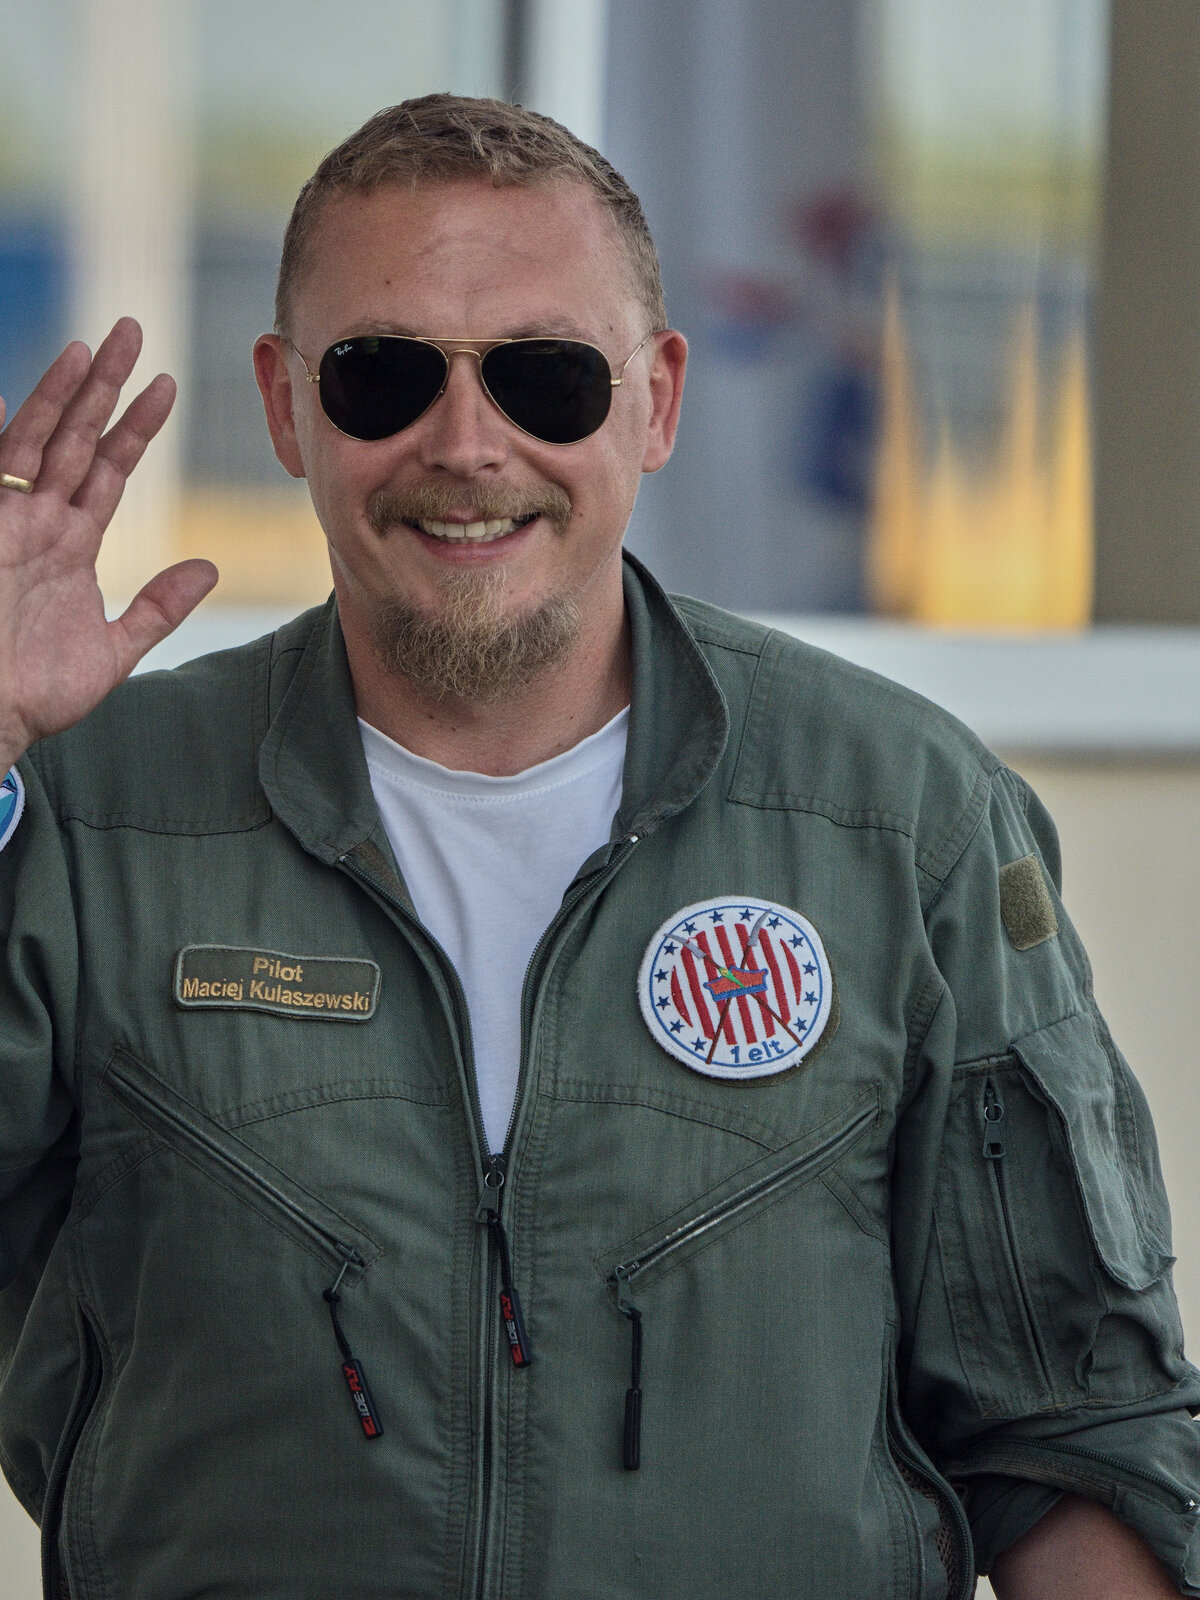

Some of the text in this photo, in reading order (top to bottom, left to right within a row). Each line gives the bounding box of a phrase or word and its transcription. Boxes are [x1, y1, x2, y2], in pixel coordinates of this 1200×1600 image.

[253, 957, 303, 982] Pilot
[183, 977, 369, 1010] Maciej Kulaszewski
